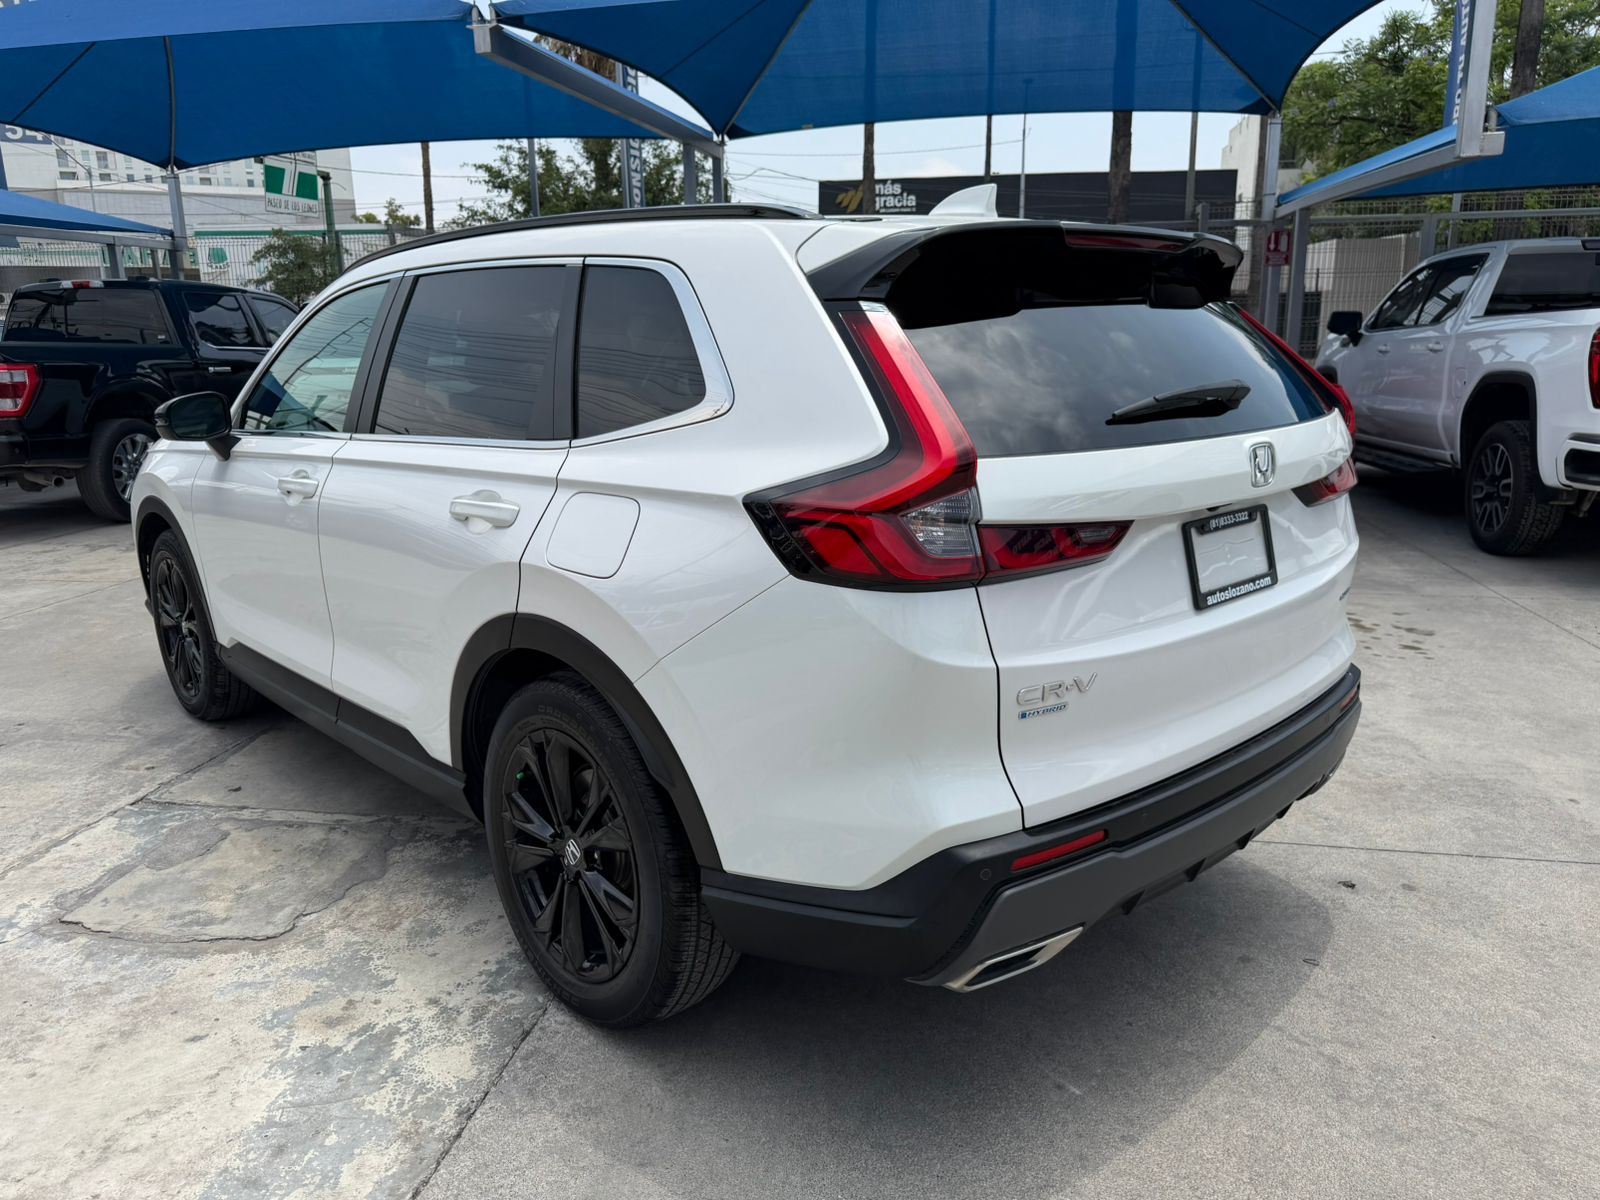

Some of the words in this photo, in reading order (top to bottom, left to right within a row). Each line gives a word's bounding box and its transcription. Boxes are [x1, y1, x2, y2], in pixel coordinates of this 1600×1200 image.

[1206, 576, 1272, 606] autoslozano.com
[1016, 672, 1098, 706] CR-V
[1027, 704, 1067, 718] HYBRID
